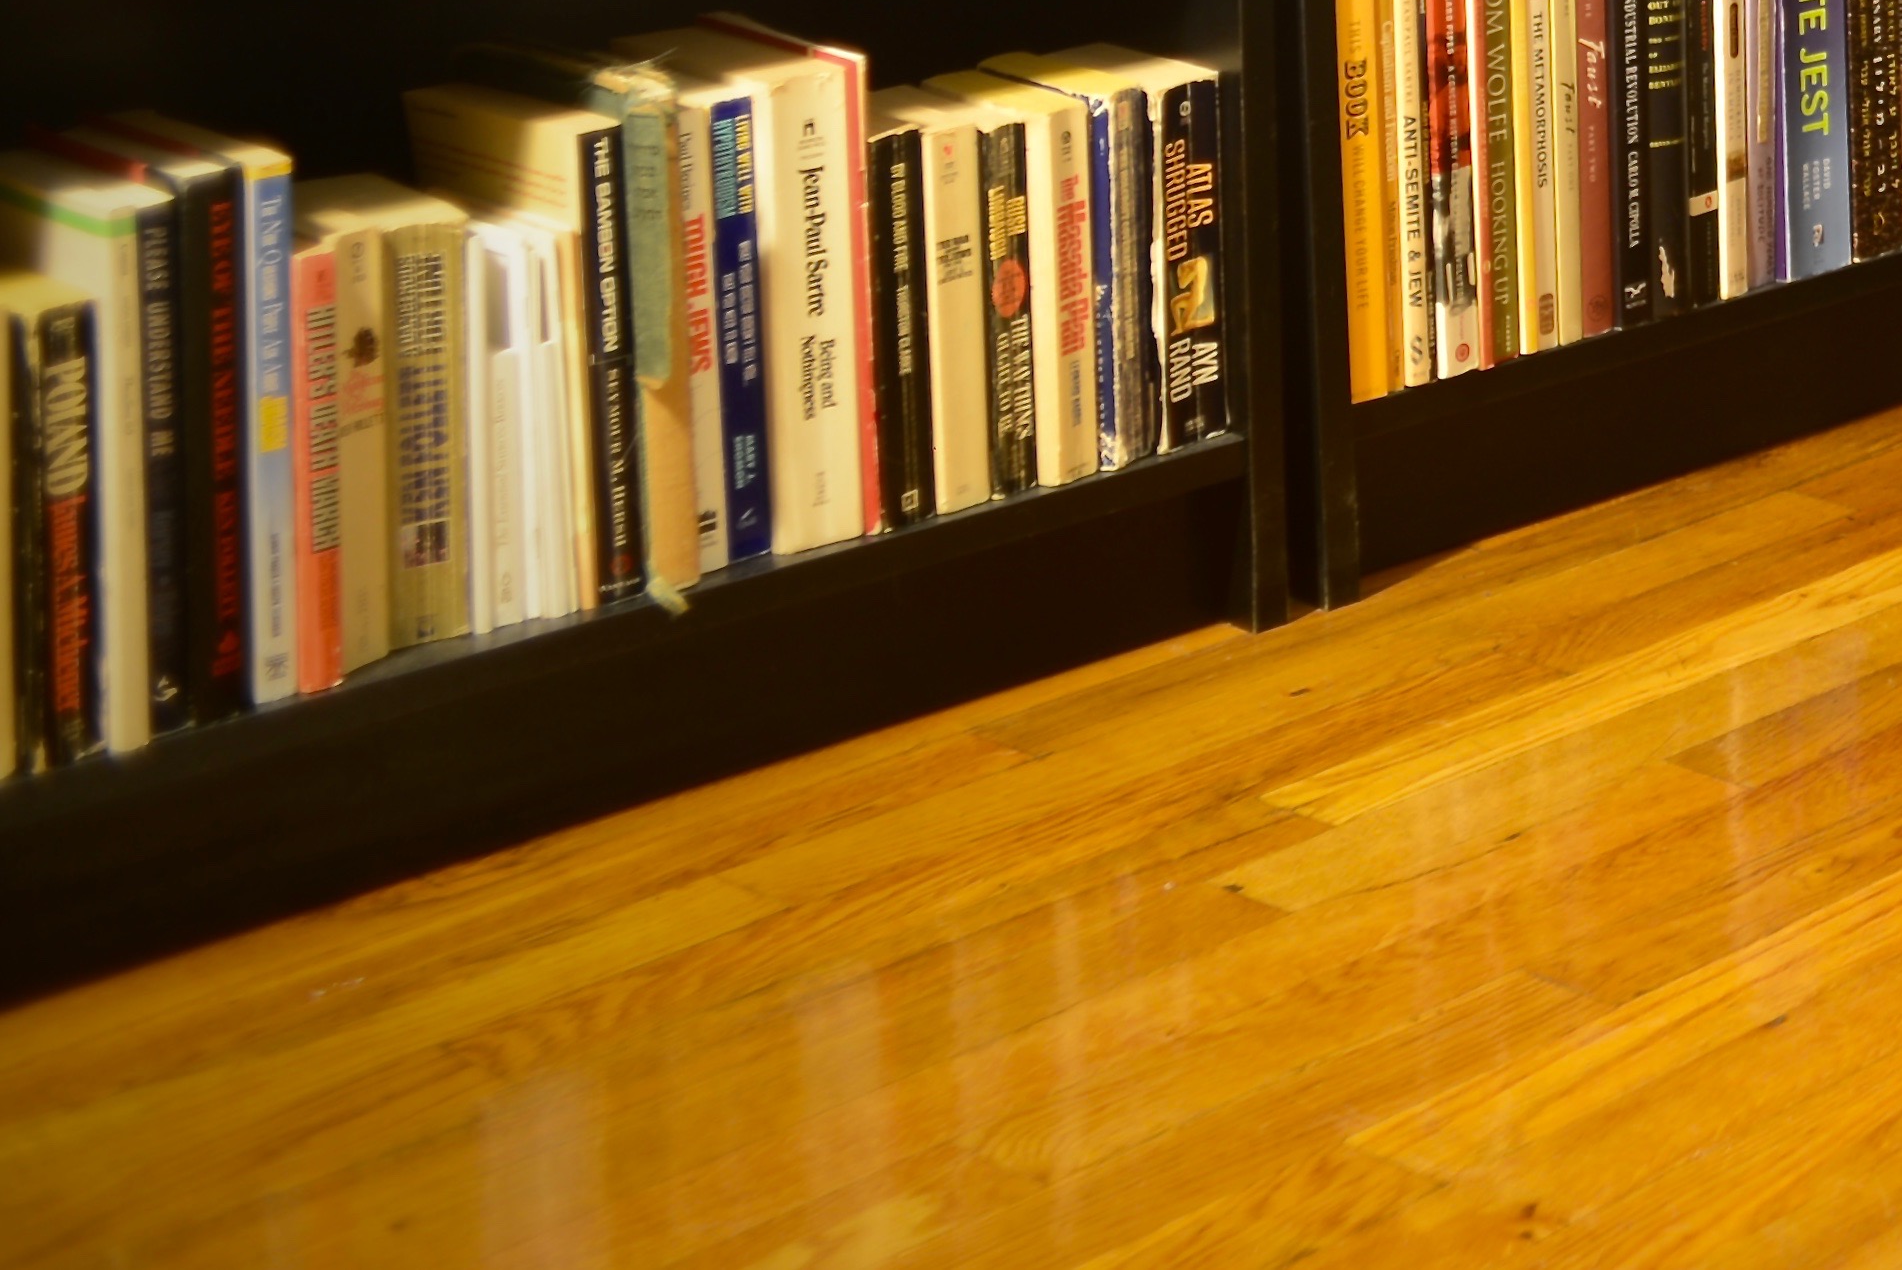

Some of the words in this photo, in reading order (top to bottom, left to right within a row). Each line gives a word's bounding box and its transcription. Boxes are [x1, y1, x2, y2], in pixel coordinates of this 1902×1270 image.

[1799, 49, 1829, 134] JEST
[798, 165, 827, 255] Jean-Paul
[1164, 138, 1188, 261] SHRUGGED
[1186, 162, 1212, 227] ATLAS
[1405, 115, 1419, 239] ANTI-SEMITE
[806, 262, 829, 316] Sartre
[1407, 250, 1419, 261] &
[1407, 268, 1422, 307] JEW
